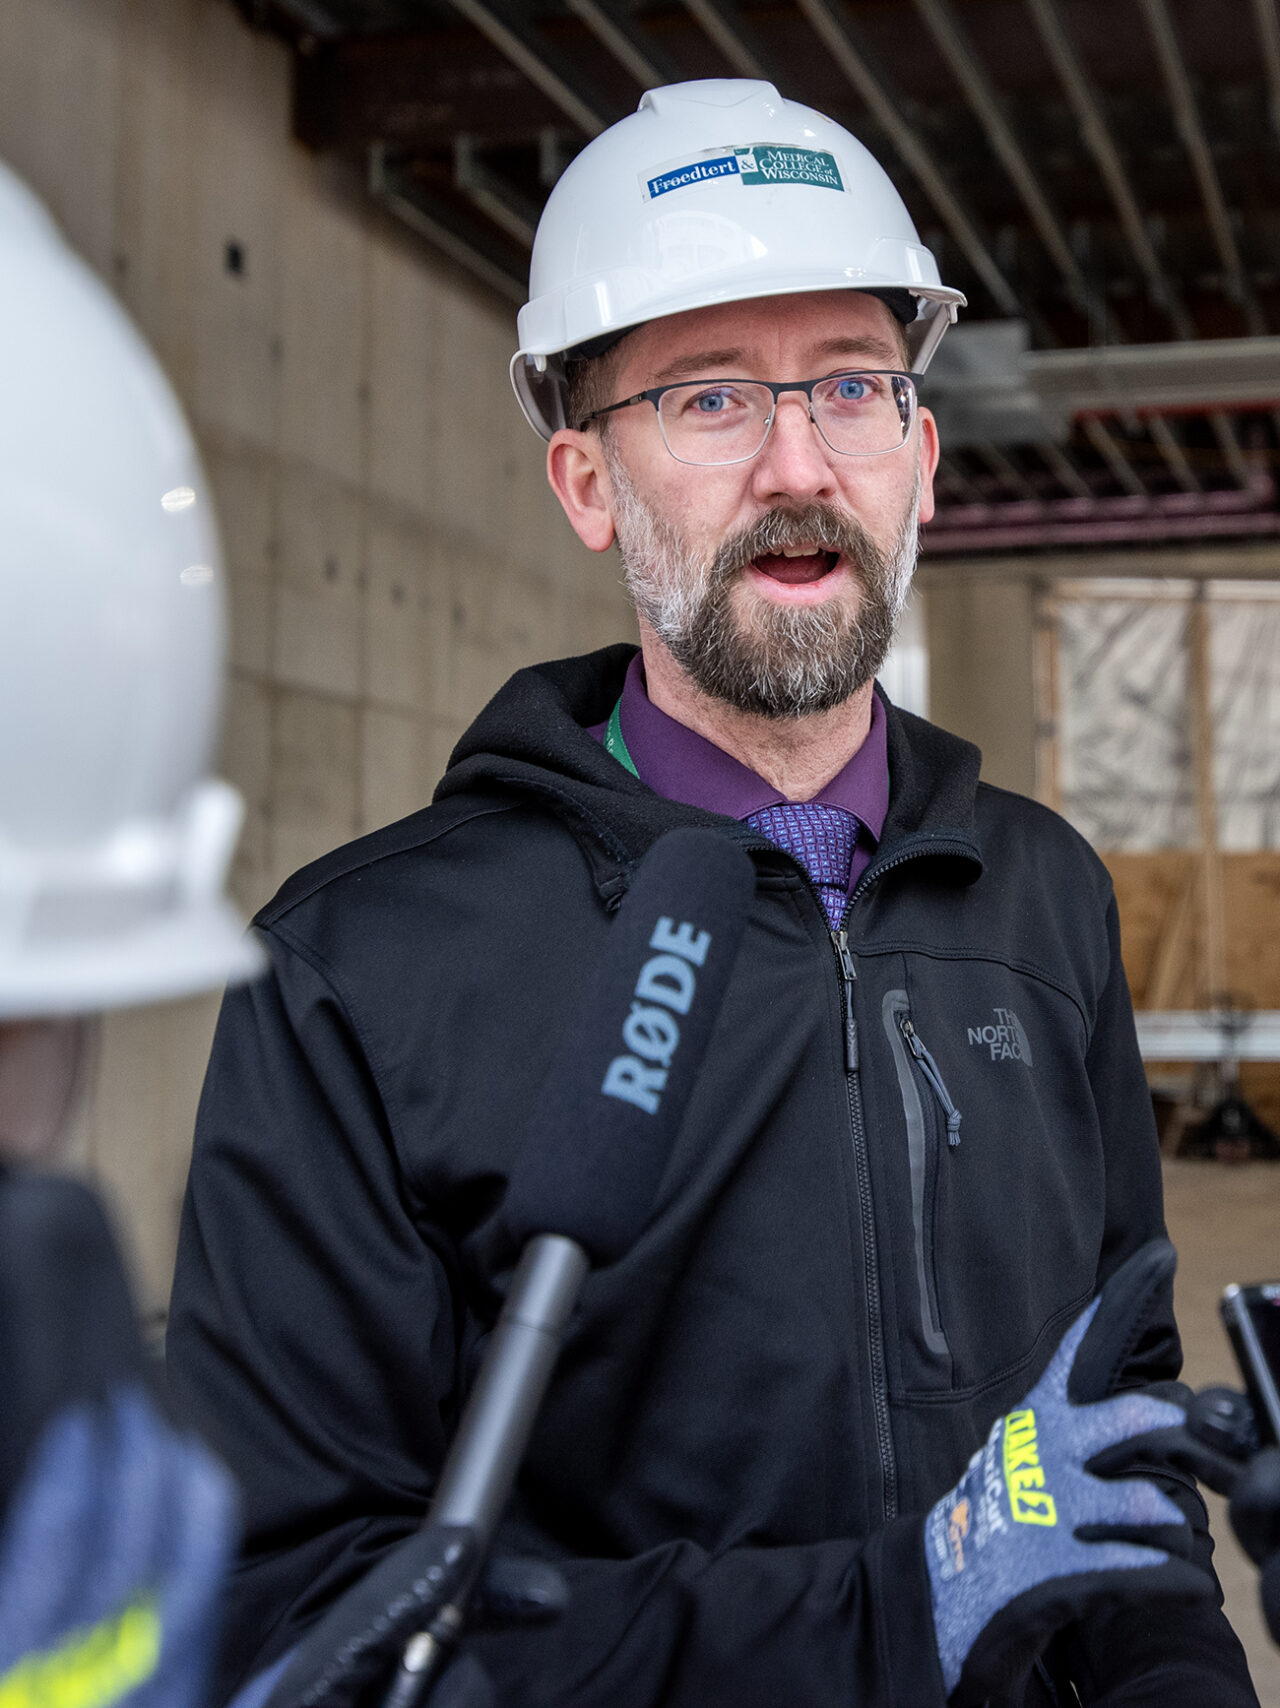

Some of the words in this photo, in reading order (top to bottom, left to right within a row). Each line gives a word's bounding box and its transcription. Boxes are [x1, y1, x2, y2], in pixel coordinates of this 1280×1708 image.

[759, 158, 821, 174] COLLEGE
[650, 160, 735, 195] Froedtert
[740, 158, 755, 171] &
[762, 169, 839, 186] WISCONSIN
